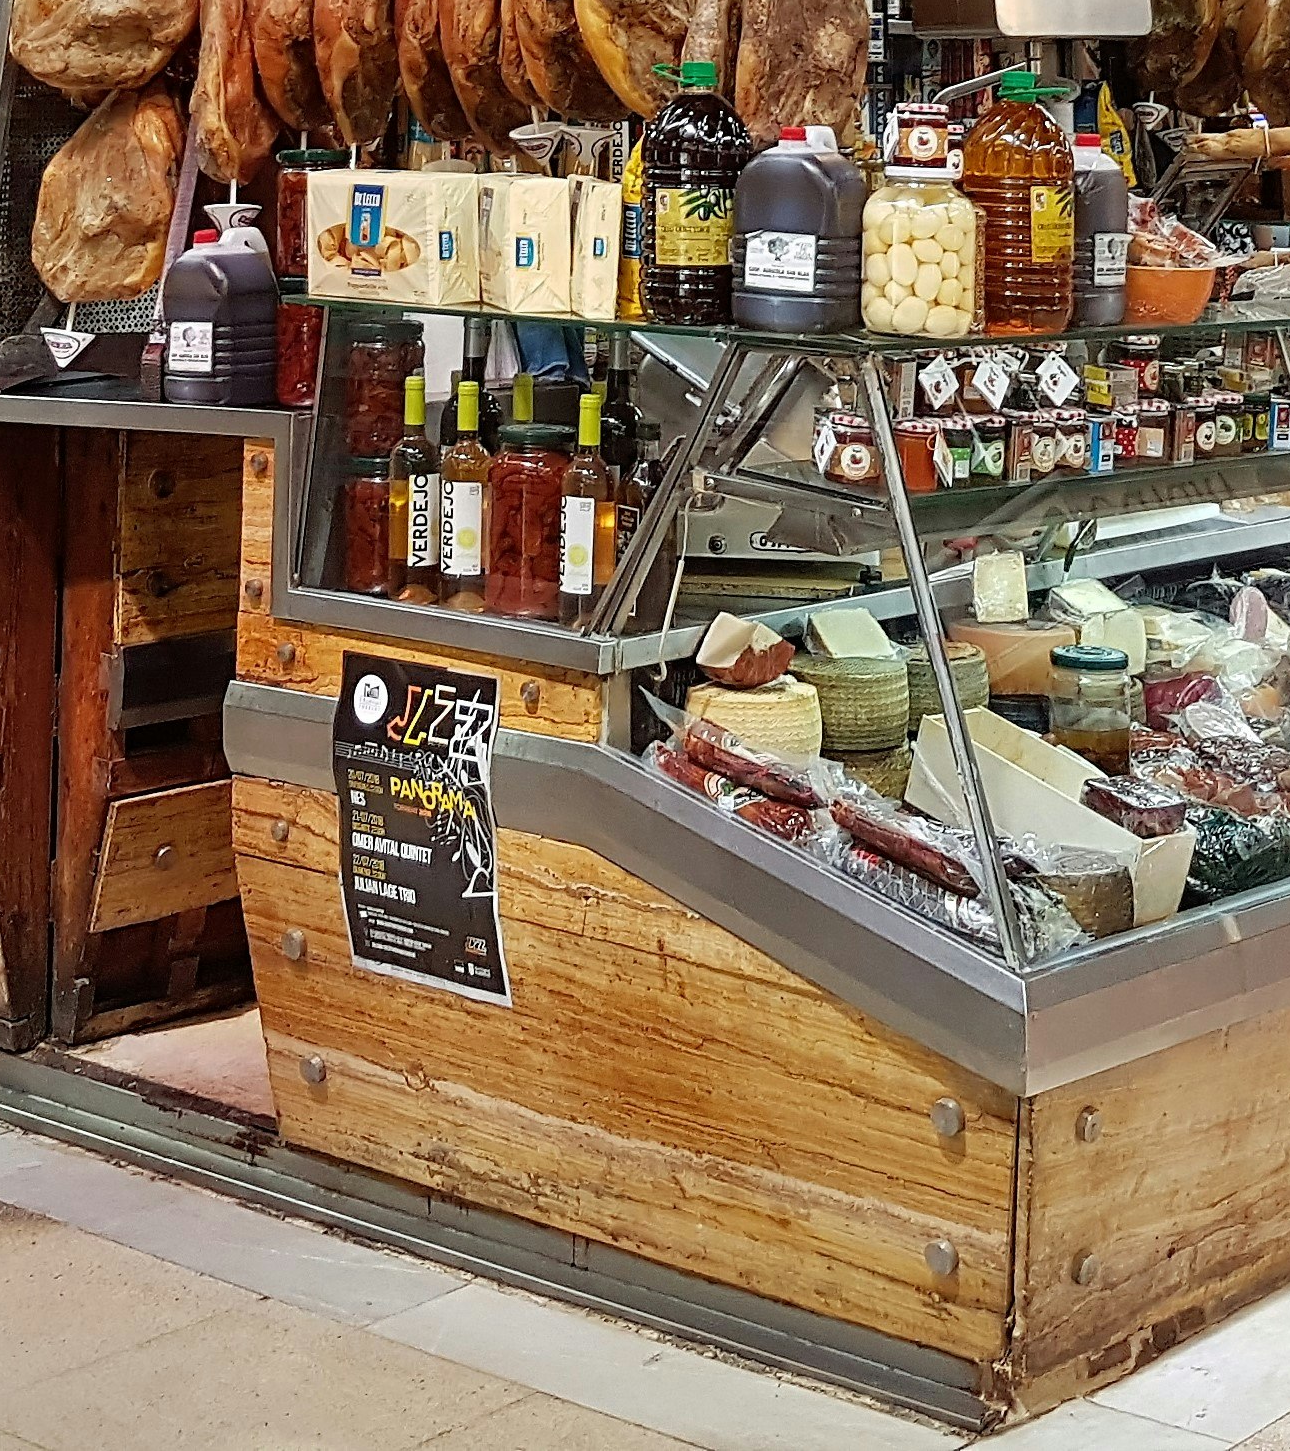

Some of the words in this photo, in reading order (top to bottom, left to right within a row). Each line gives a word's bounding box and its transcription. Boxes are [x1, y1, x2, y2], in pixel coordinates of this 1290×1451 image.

[412, 473, 429, 567] VERDEJO
[440, 481, 454, 573] VERDEJO
[389, 776, 478, 821] PANORAMA
